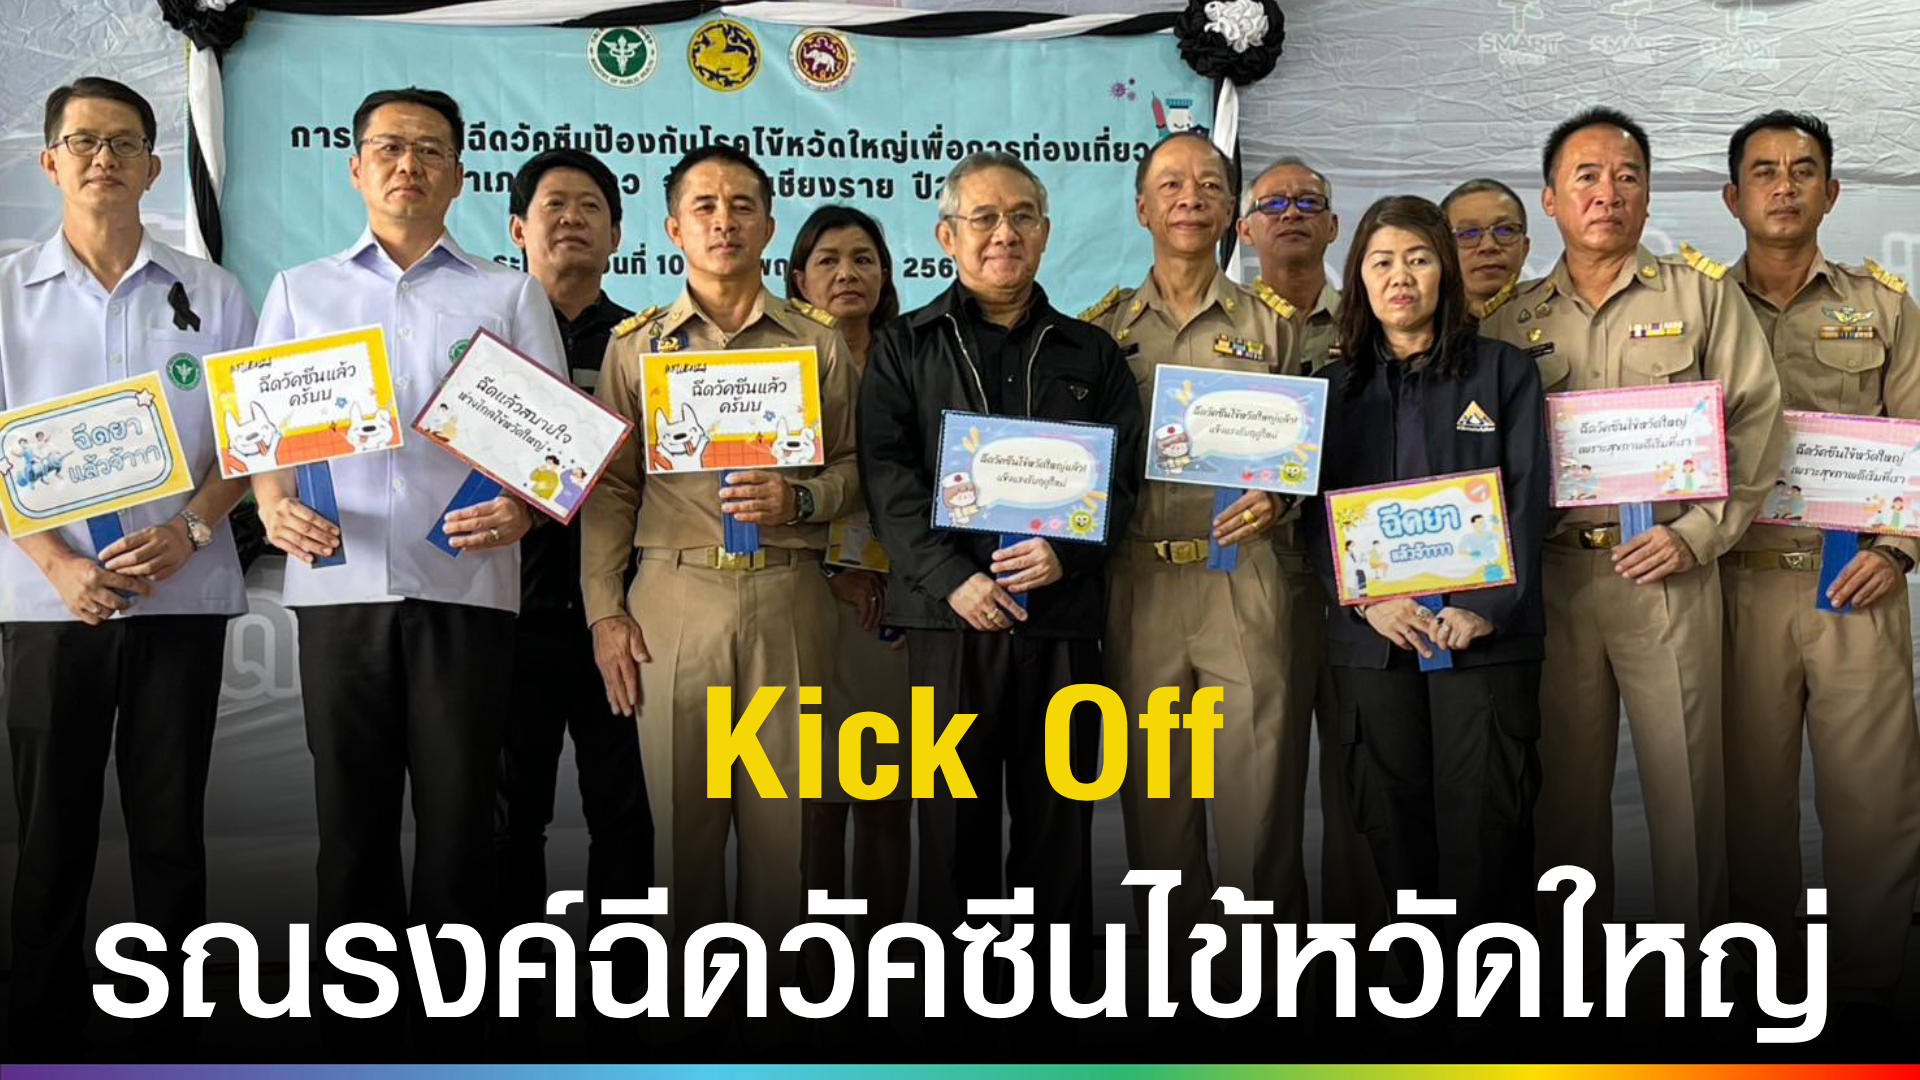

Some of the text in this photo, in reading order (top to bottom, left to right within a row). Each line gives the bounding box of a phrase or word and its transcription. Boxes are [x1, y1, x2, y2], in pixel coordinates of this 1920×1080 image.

[903, 257, 958, 278] 256
[258, 362, 357, 393] ฉีดวัคซีนแล้ว
[692, 376, 787, 397] ฉีดวัคซีนแล้ว
[458, 390, 547, 452] ห่างไกลไข้หวัดใหญ่
[476, 376, 572, 444] ฉีดแล้วสบายใจ
[72, 416, 143, 450] ฉีดยา
[1377, 502, 1462, 539] ฉีดยา
